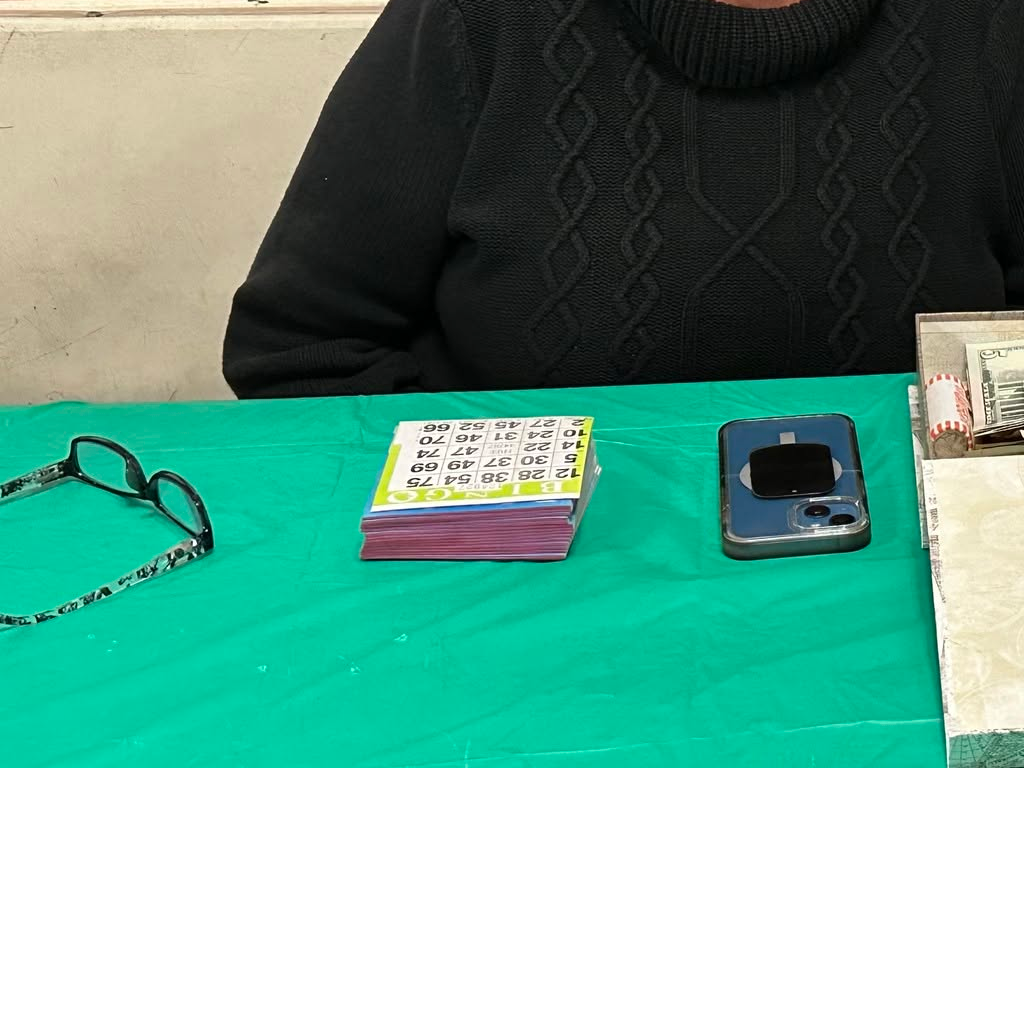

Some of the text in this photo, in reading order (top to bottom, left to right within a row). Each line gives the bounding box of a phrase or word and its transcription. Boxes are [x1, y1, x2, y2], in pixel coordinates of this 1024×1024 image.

[424, 424, 450, 432] 66
[459, 422, 485, 430] 52
[420, 429, 587, 445] 10 24 31 46 70
[523, 442, 551, 451] 22
[562, 441, 584, 450] 14
[416, 449, 440, 458] 74
[451, 447, 479, 456] 47
[410, 454, 578, 472] 5 30 37 49 69
[405, 468, 580, 487] 12 28 38 54 75
[387, 481, 563, 504] BINGO
